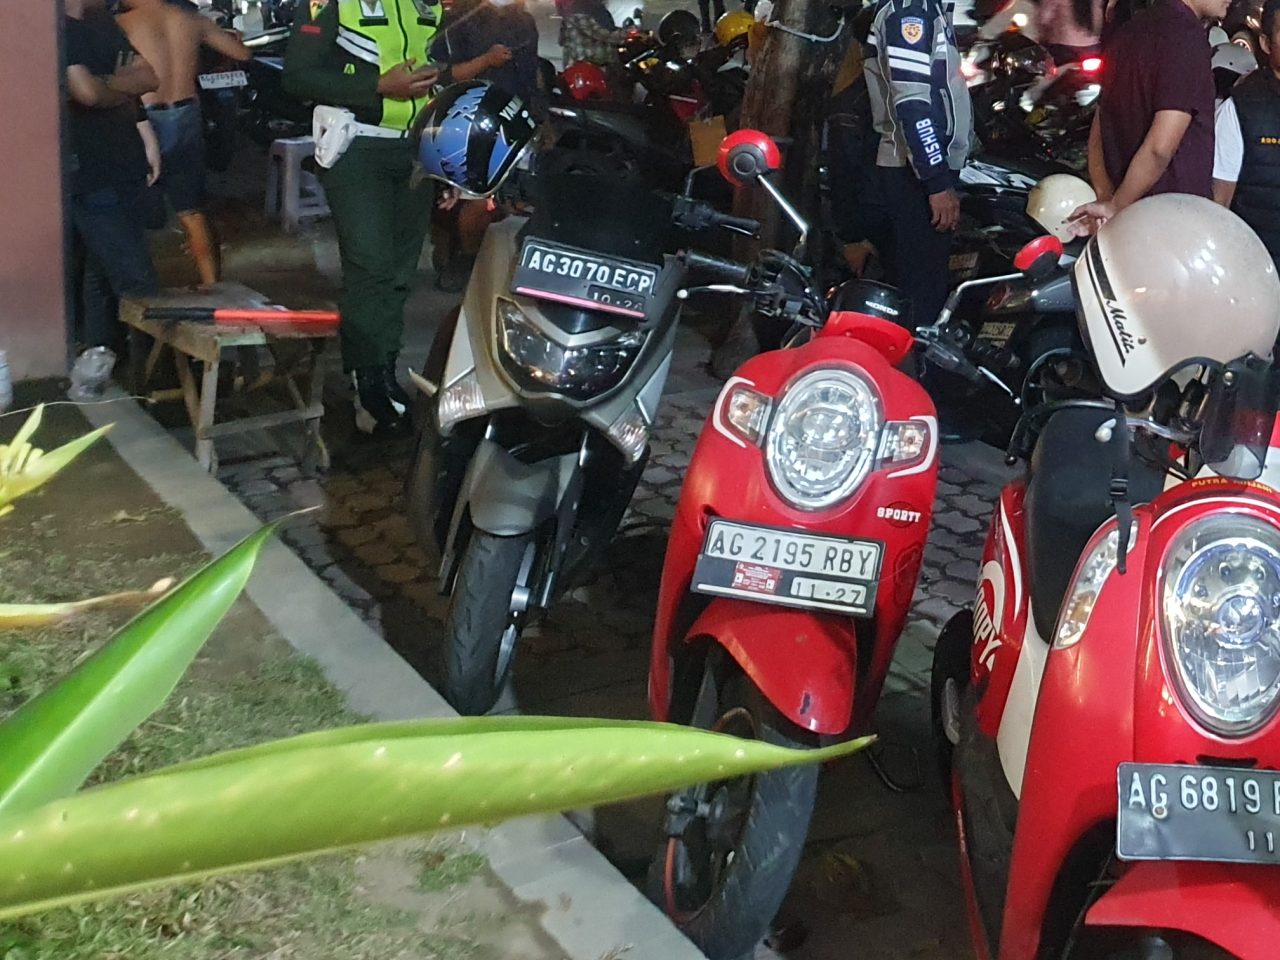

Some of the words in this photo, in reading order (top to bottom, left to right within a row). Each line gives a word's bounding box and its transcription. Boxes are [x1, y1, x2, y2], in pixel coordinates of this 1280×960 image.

[916, 118, 942, 165] DISHUB
[528, 250, 556, 273] AG
[557, 256, 611, 284] 3070
[612, 268, 651, 292] ECP
[1191, 478, 1229, 488] PUTRA
[876, 506, 921, 523] SPORTY
[710, 529, 745, 557] AG
[750, 536, 815, 568] 2195
[822, 546, 873, 576] RBY
[1128, 771, 1168, 811] AG
[1179, 774, 1262, 814] 6819
